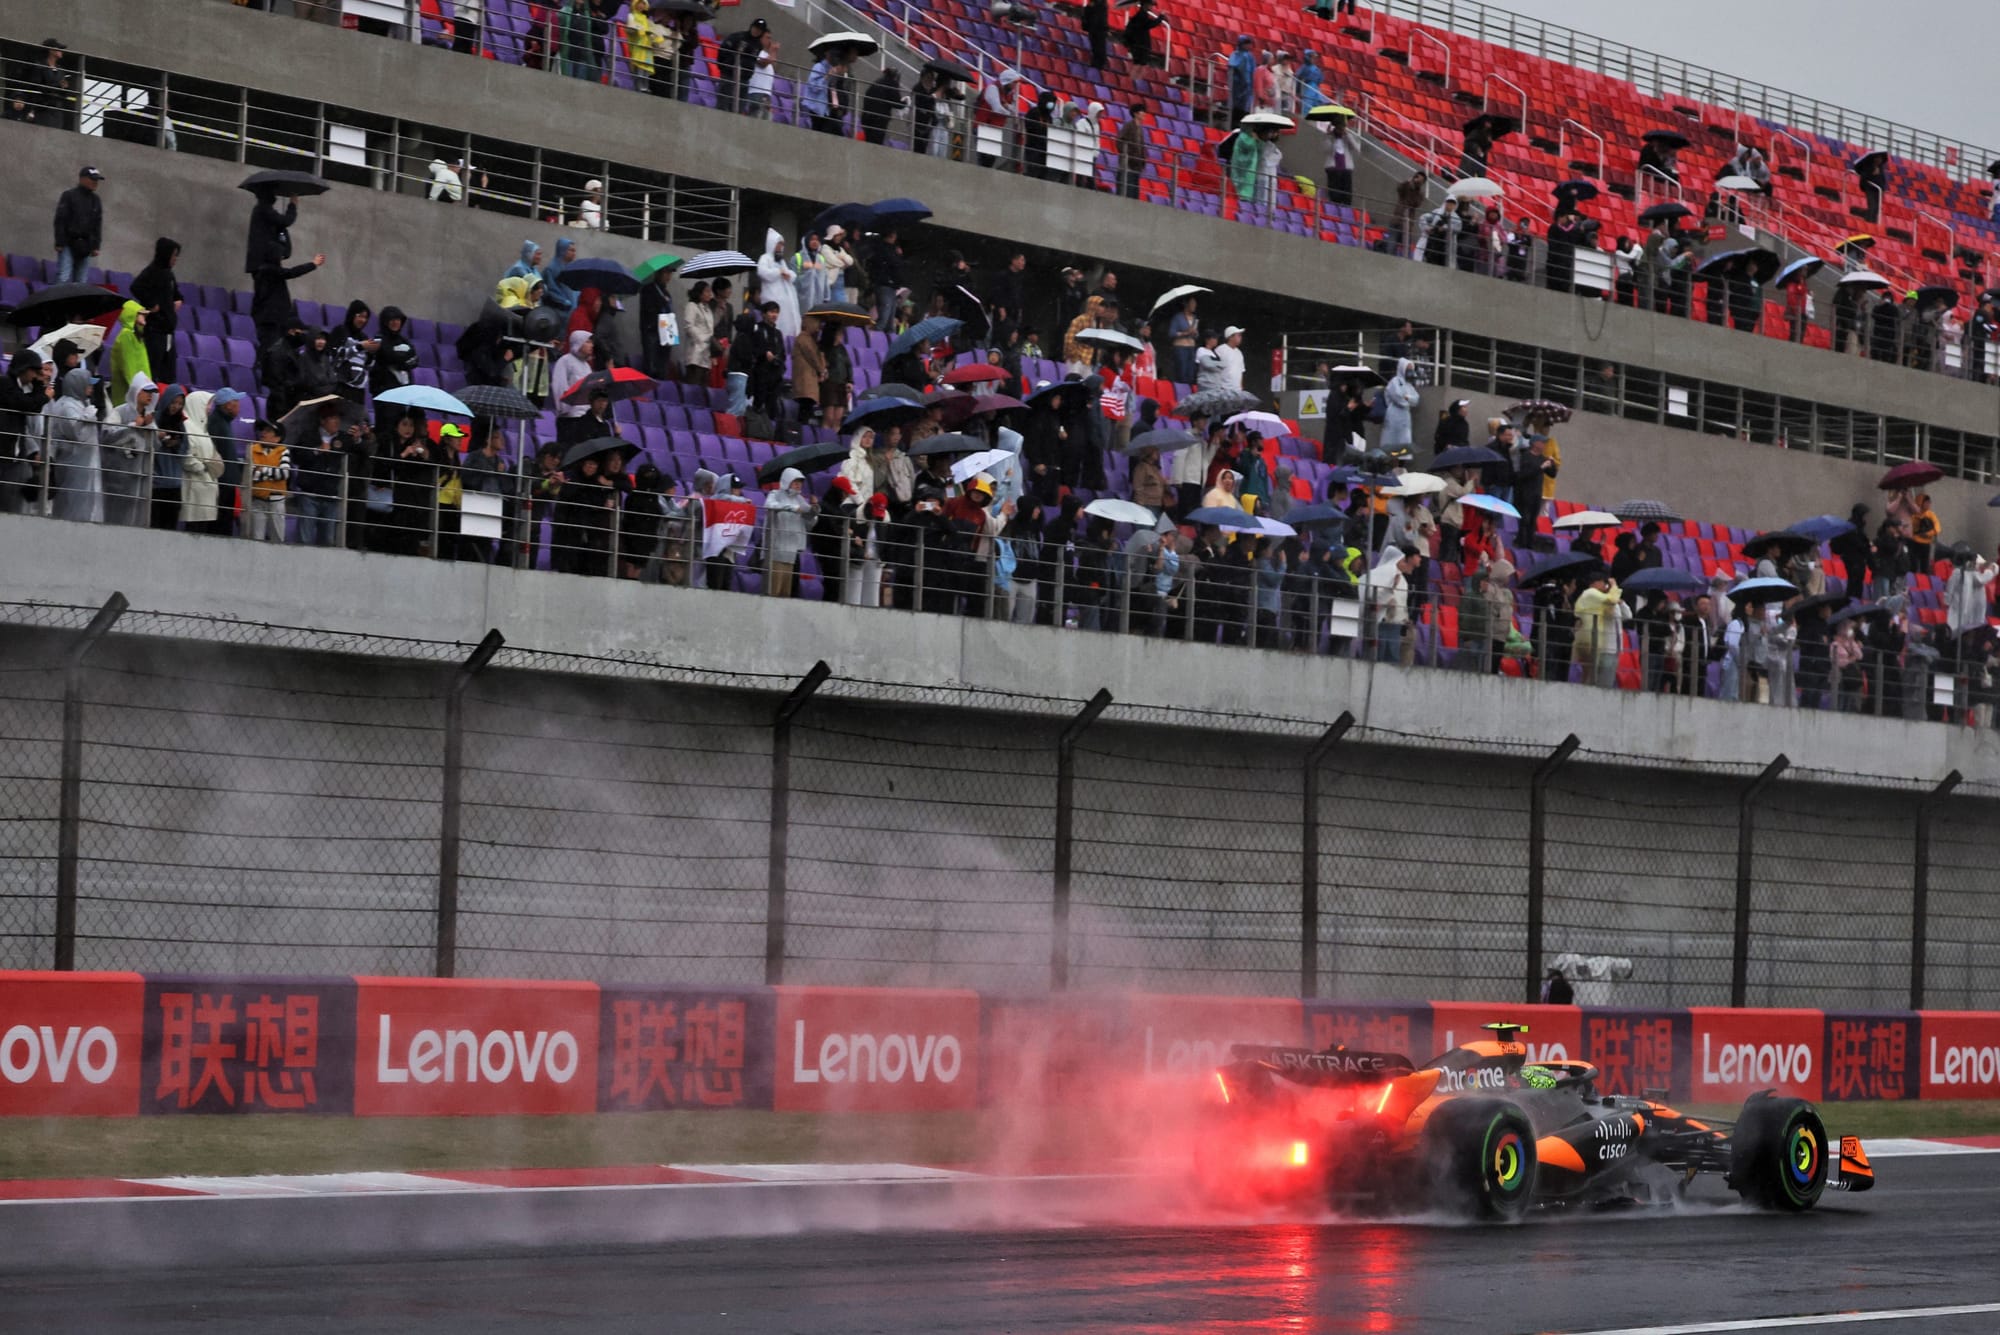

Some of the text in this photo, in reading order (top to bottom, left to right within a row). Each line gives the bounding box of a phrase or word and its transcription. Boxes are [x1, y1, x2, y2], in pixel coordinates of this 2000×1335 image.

[155, 993, 319, 1109] 联想
[377, 1014, 579, 1083] Lenovo
[610, 1000, 746, 1105] 联想
[793, 1019, 962, 1083] Lenovo
[1265, 1051, 1386, 1074] ARKTRACE
[1588, 1019, 1673, 1096] 联想
[1703, 1033, 1812, 1084] Lenovo
[1828, 1021, 1907, 1099] 联想
